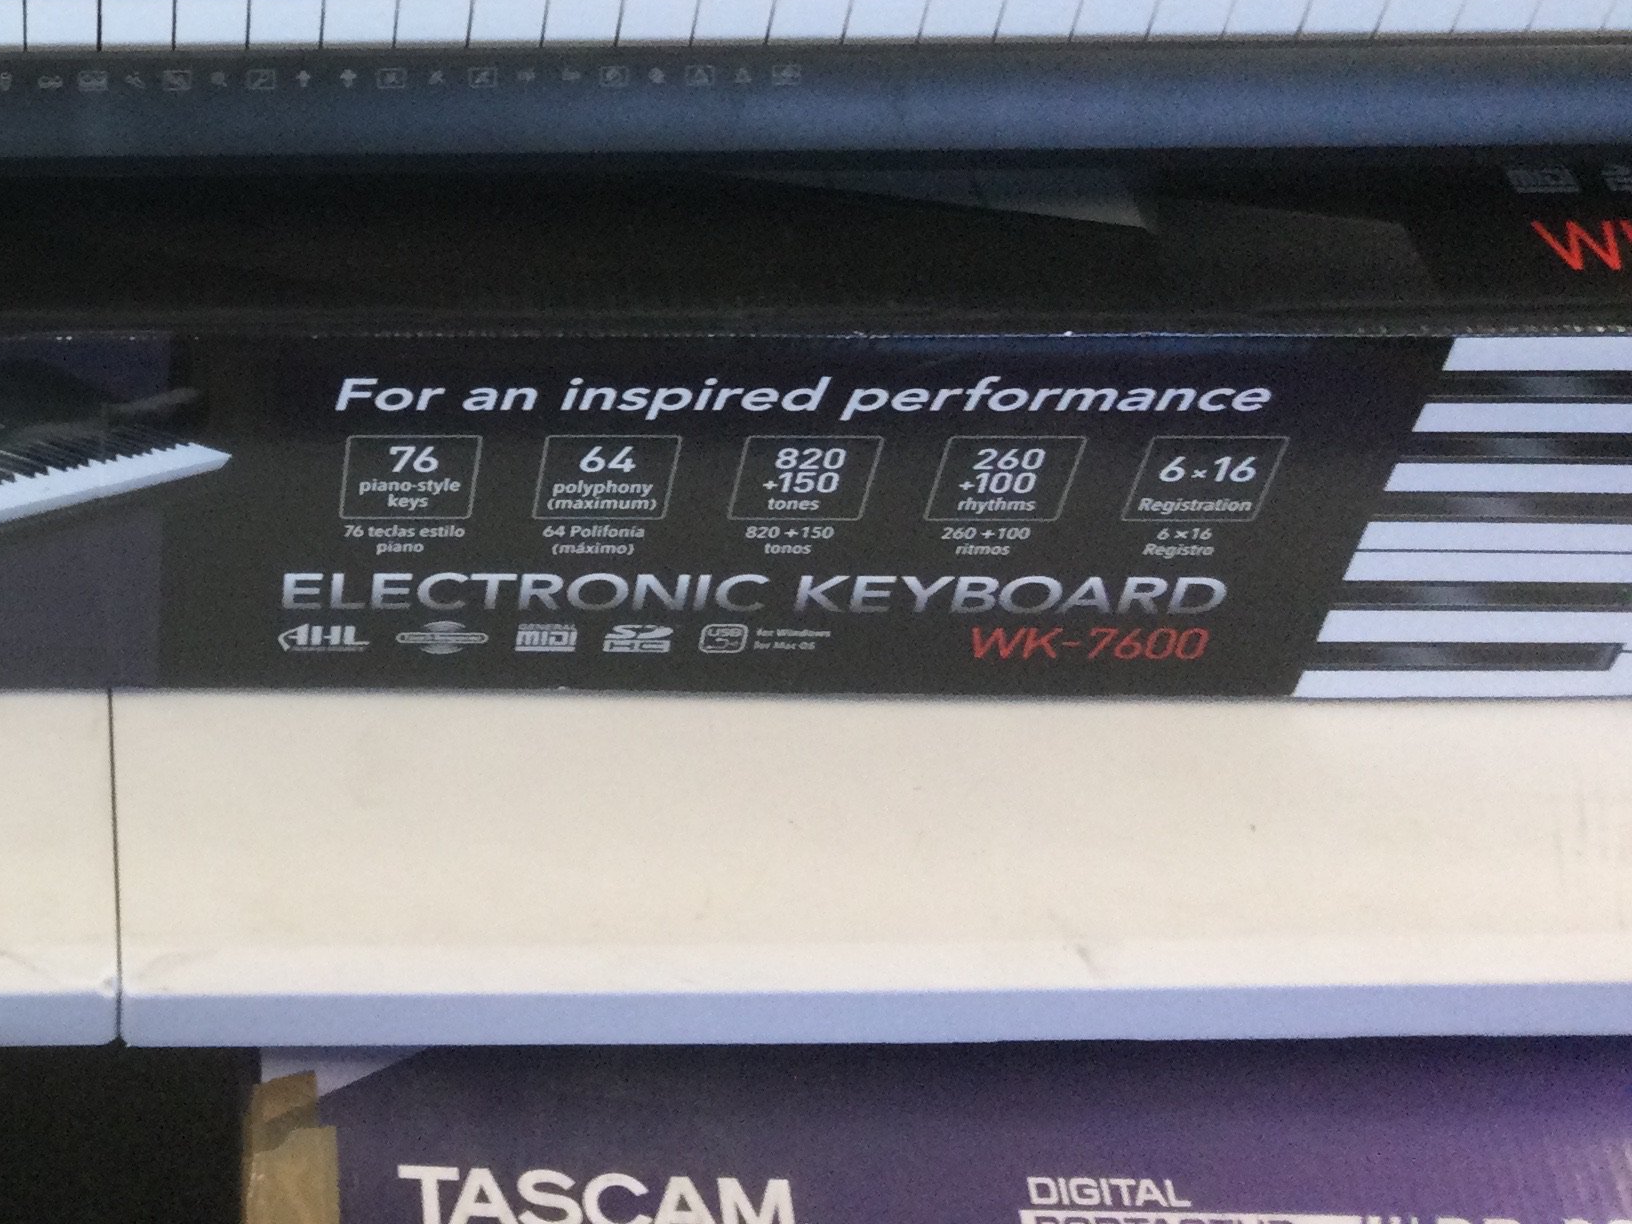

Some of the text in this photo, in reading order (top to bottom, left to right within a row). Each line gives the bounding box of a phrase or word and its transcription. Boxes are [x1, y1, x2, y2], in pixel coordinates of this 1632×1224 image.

[1530, 219, 1632, 271] W
[334, 376, 1271, 422] For an inspired performance
[388, 445, 440, 474] 76
[579, 445, 637, 474] 64
[775, 446, 847, 471] 820
[972, 446, 1046, 471] 260
[358, 477, 461, 496] piano-style
[552, 479, 654, 498] polyphony
[762, 471, 840, 495] +150
[958, 472, 1037, 495] +100
[386, 493, 429, 511] keys
[546, 494, 658, 512] (maximum)
[767, 496, 821, 512] tones
[956, 495, 1036, 515] rhythms
[1137, 496, 1253, 516] Registration
[343, 524, 466, 538] 76 teclas estilo
[542, 524, 566, 538] 64
[744, 525, 780, 540] 820
[941, 525, 979, 541] 260
[376, 540, 424, 555] piano
[764, 541, 812, 555] tonos
[281, 571, 1229, 615] ELECTRONIC KEYBOARD
[707, 626, 744, 637] USB
[971, 626, 1210, 661] WK-7600
[397, 1164, 797, 1224] TASCAM
[1025, 1176, 1193, 1207] DIGITAL
